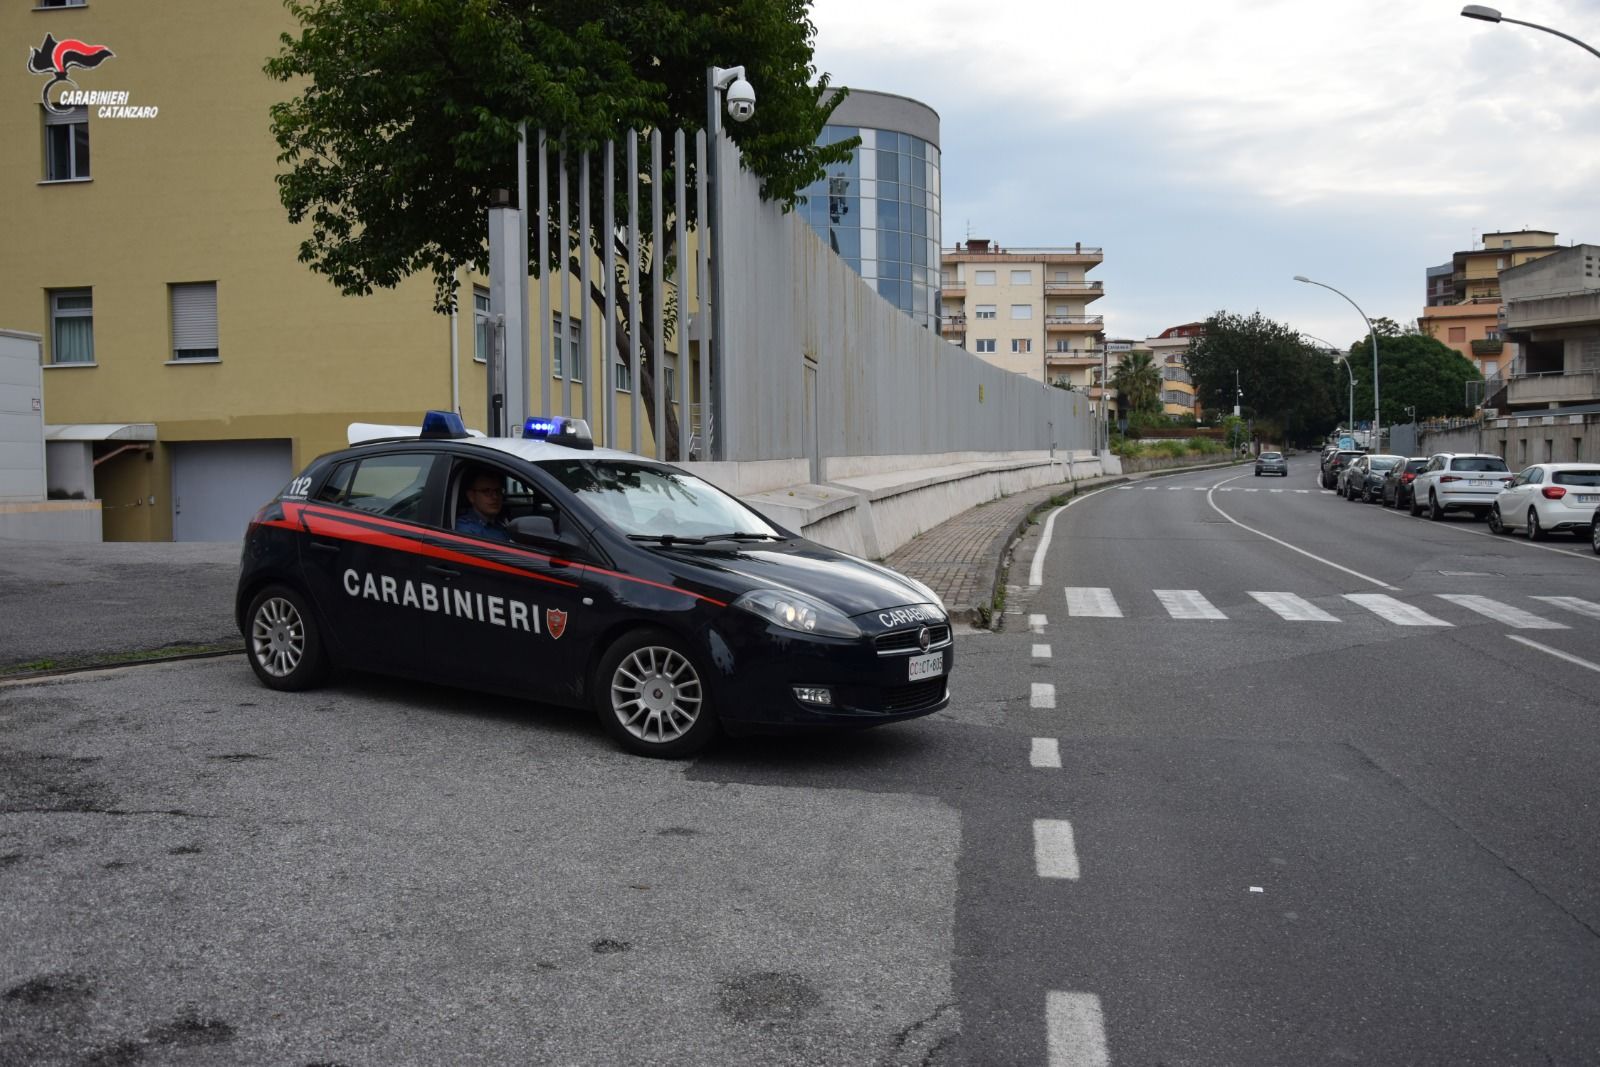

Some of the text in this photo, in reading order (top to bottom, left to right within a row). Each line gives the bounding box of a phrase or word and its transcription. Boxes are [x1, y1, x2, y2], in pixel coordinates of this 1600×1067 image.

[290, 477, 312, 496] 112
[343, 568, 541, 634] CARABINIERI
[879, 607, 940, 628] CARABIN
